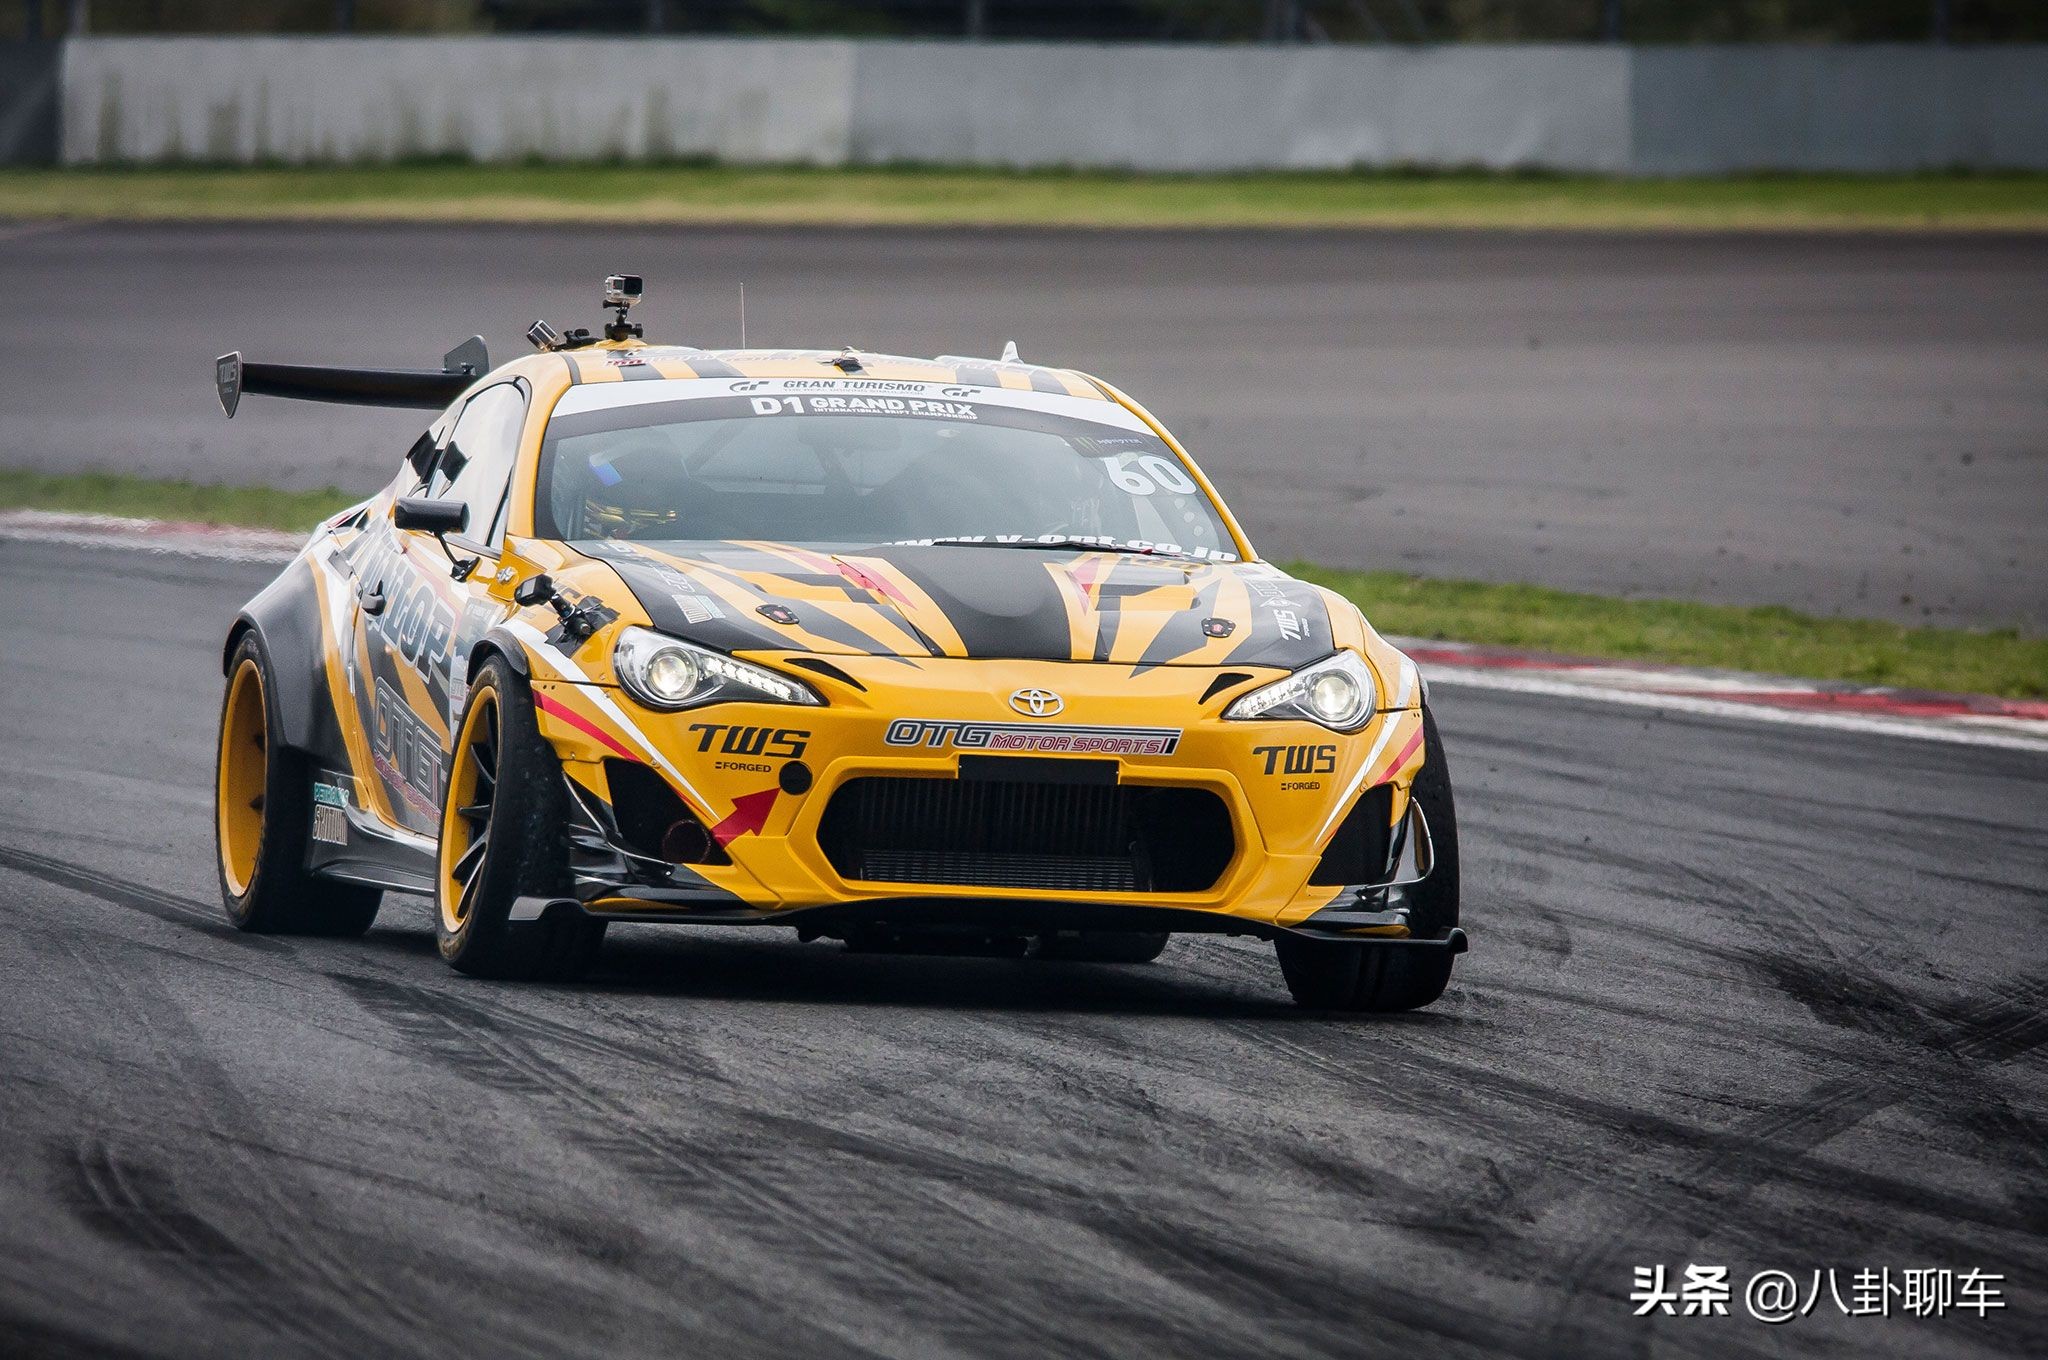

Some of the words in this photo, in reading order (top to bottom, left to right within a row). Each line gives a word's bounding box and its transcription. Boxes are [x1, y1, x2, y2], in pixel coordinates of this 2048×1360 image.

[783, 380, 835, 389] GRAN
[842, 381, 926, 393] TURISMO
[750, 396, 805, 415] D1
[809, 397, 908, 410] GRAND
[911, 399, 976, 416] PRIX
[912, 410, 979, 420] CHAMPIONSHIP
[1104, 455, 1197, 496] 60
[688, 723, 812, 759] TWS
[884, 718, 993, 748] OTG
[989, 734, 1069, 752] MOTOR
[1071, 737, 1164, 754] SPORTS
[723, 762, 772, 773] FORGED
[1252, 745, 1337, 775] TWS
[1287, 781, 1321, 790] FORGED
